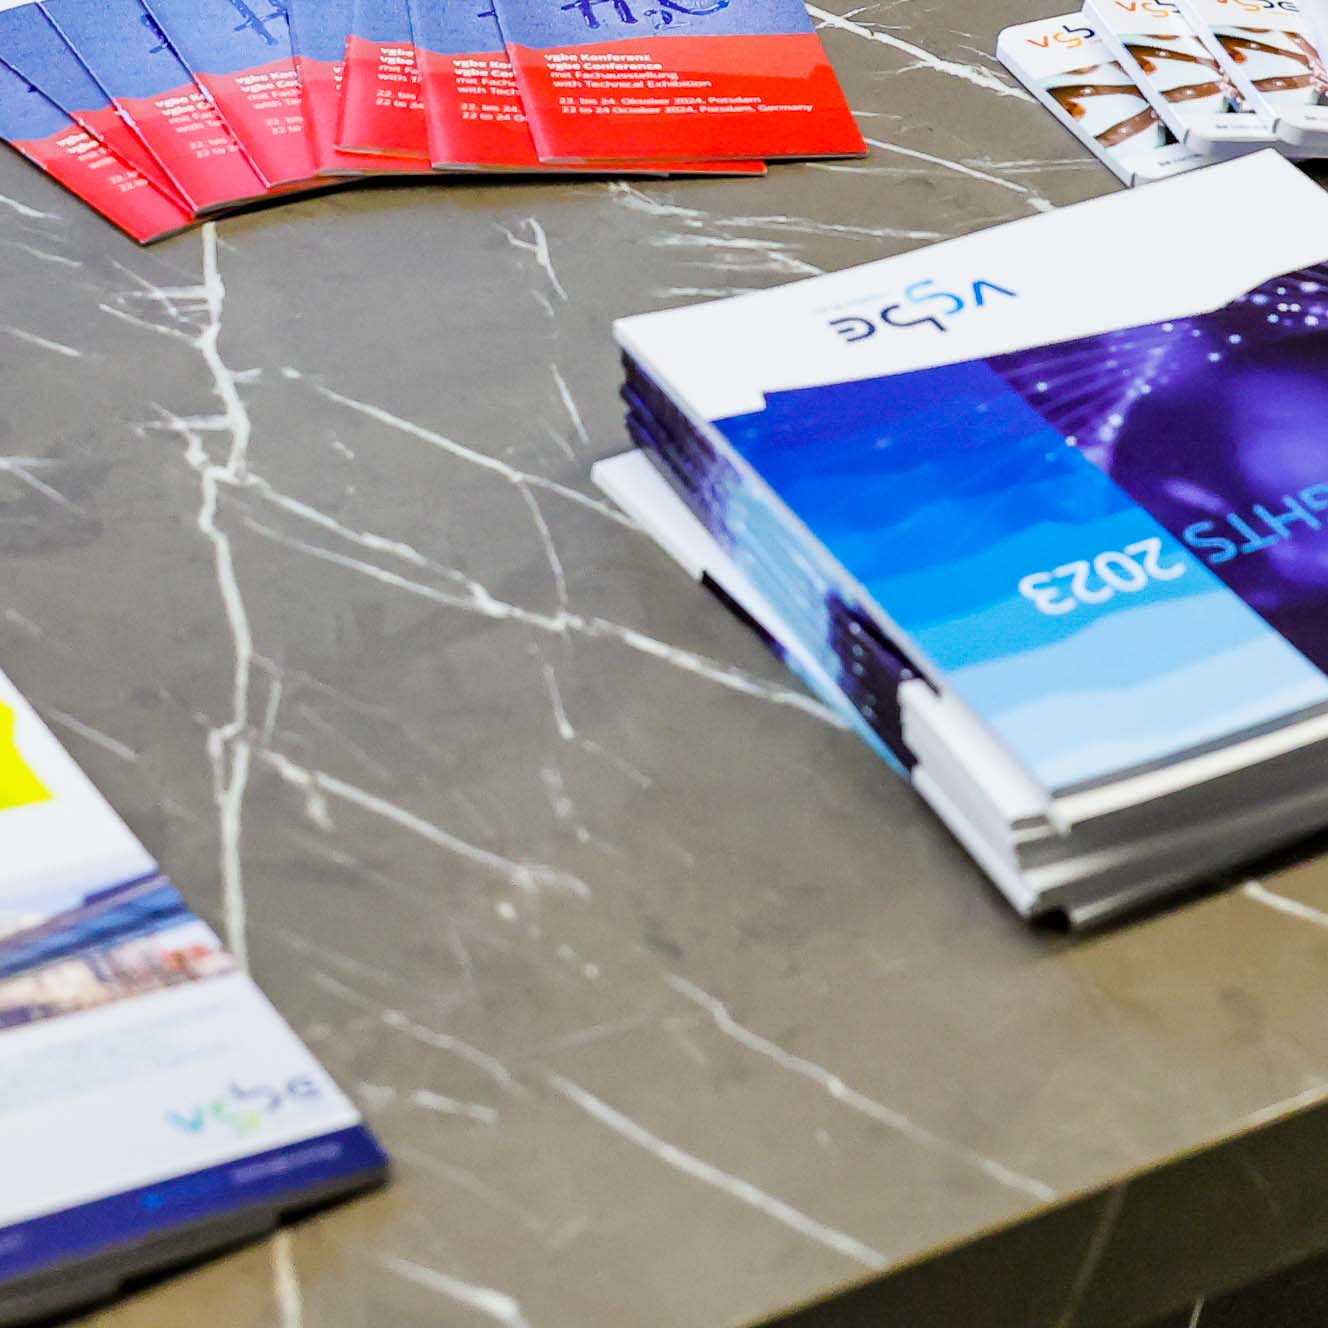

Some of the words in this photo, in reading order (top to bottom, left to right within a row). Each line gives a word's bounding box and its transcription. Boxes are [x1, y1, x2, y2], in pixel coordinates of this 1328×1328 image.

[544, 53, 578, 63] vgbe
[581, 53, 651, 62] Konferenz
[547, 62, 582, 72] vgbe
[584, 62, 662, 71] Conference
[553, 80, 582, 88] with
[585, 79, 644, 88] Technical
[648, 79, 712, 88] Exhibition
[758, 103, 813, 113] Germany
[826, 278, 1018, 343] vgbe
[1020, 536, 1186, 617] 2023
